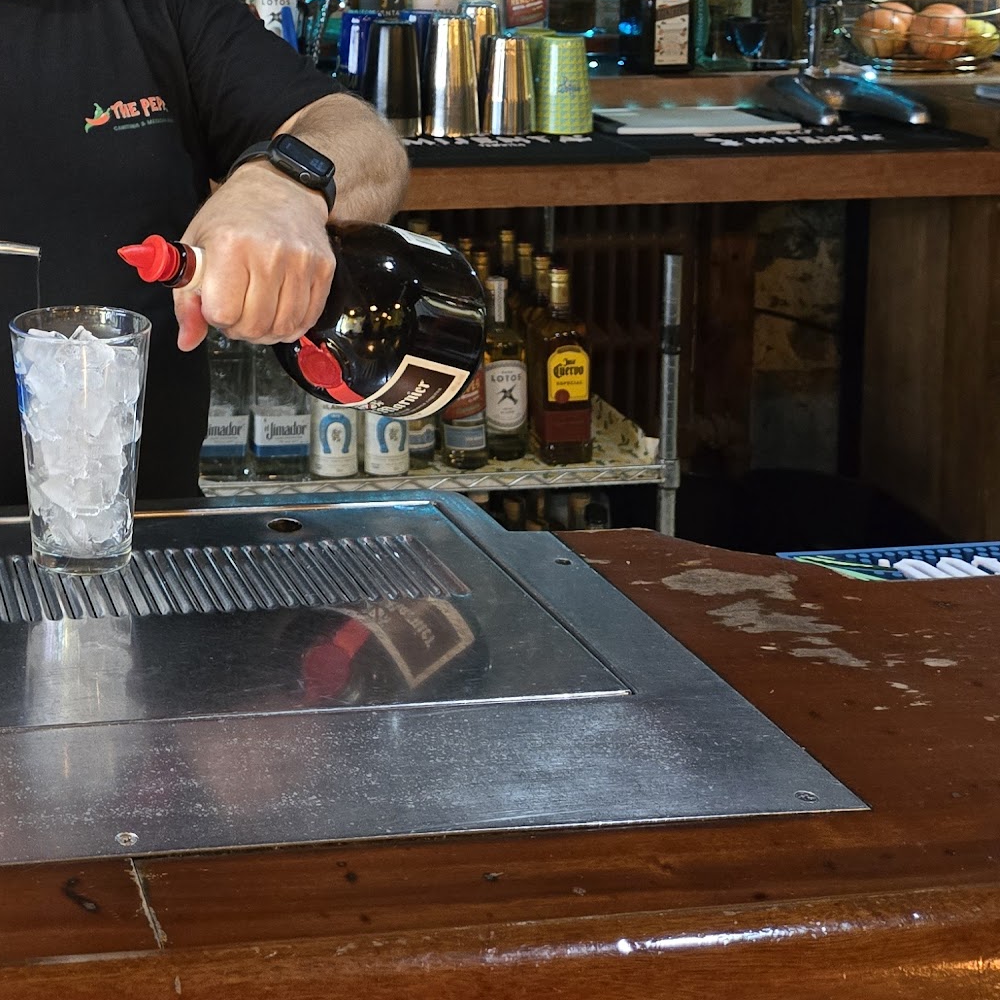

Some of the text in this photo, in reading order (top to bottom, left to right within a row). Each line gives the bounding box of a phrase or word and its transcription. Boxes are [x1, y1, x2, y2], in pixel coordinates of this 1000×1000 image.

[110, 100, 141, 119] THE
[491, 373, 522, 382] LOTOS
[553, 363, 584, 378] Cuervo
[208, 421, 243, 436] imador
[266, 421, 307, 440] Jimador
